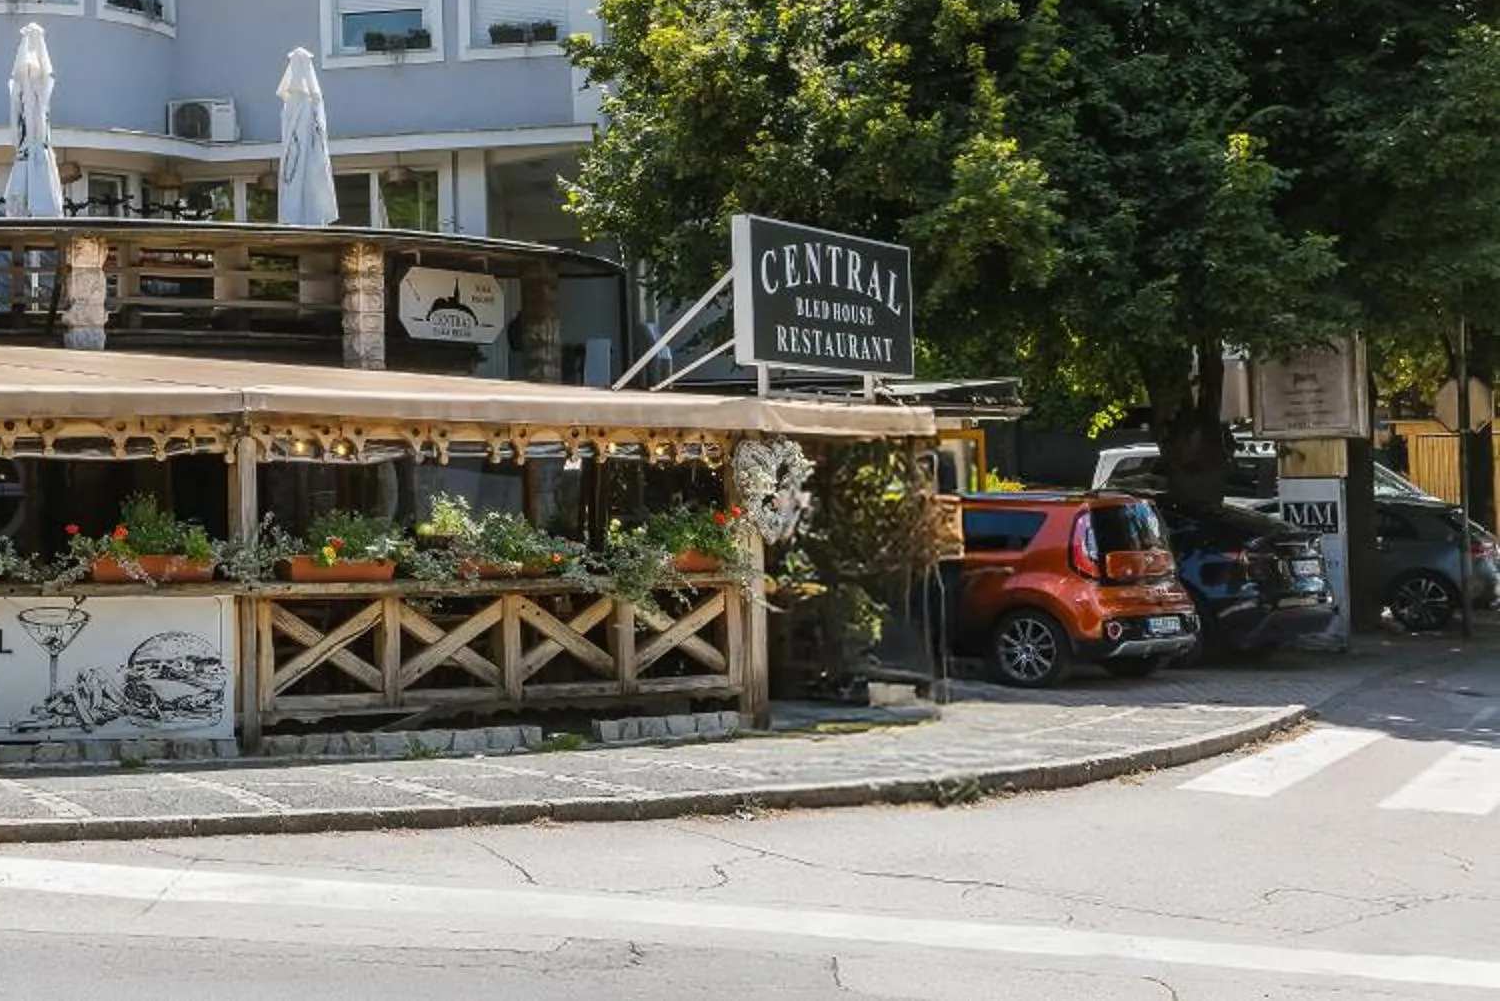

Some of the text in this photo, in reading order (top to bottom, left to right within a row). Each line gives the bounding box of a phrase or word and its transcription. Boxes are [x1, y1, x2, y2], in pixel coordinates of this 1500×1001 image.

[761, 242, 901, 316] CENTRAL
[796, 297, 875, 326] BLED HOUSE
[776, 324, 893, 363] RESTAURANT
